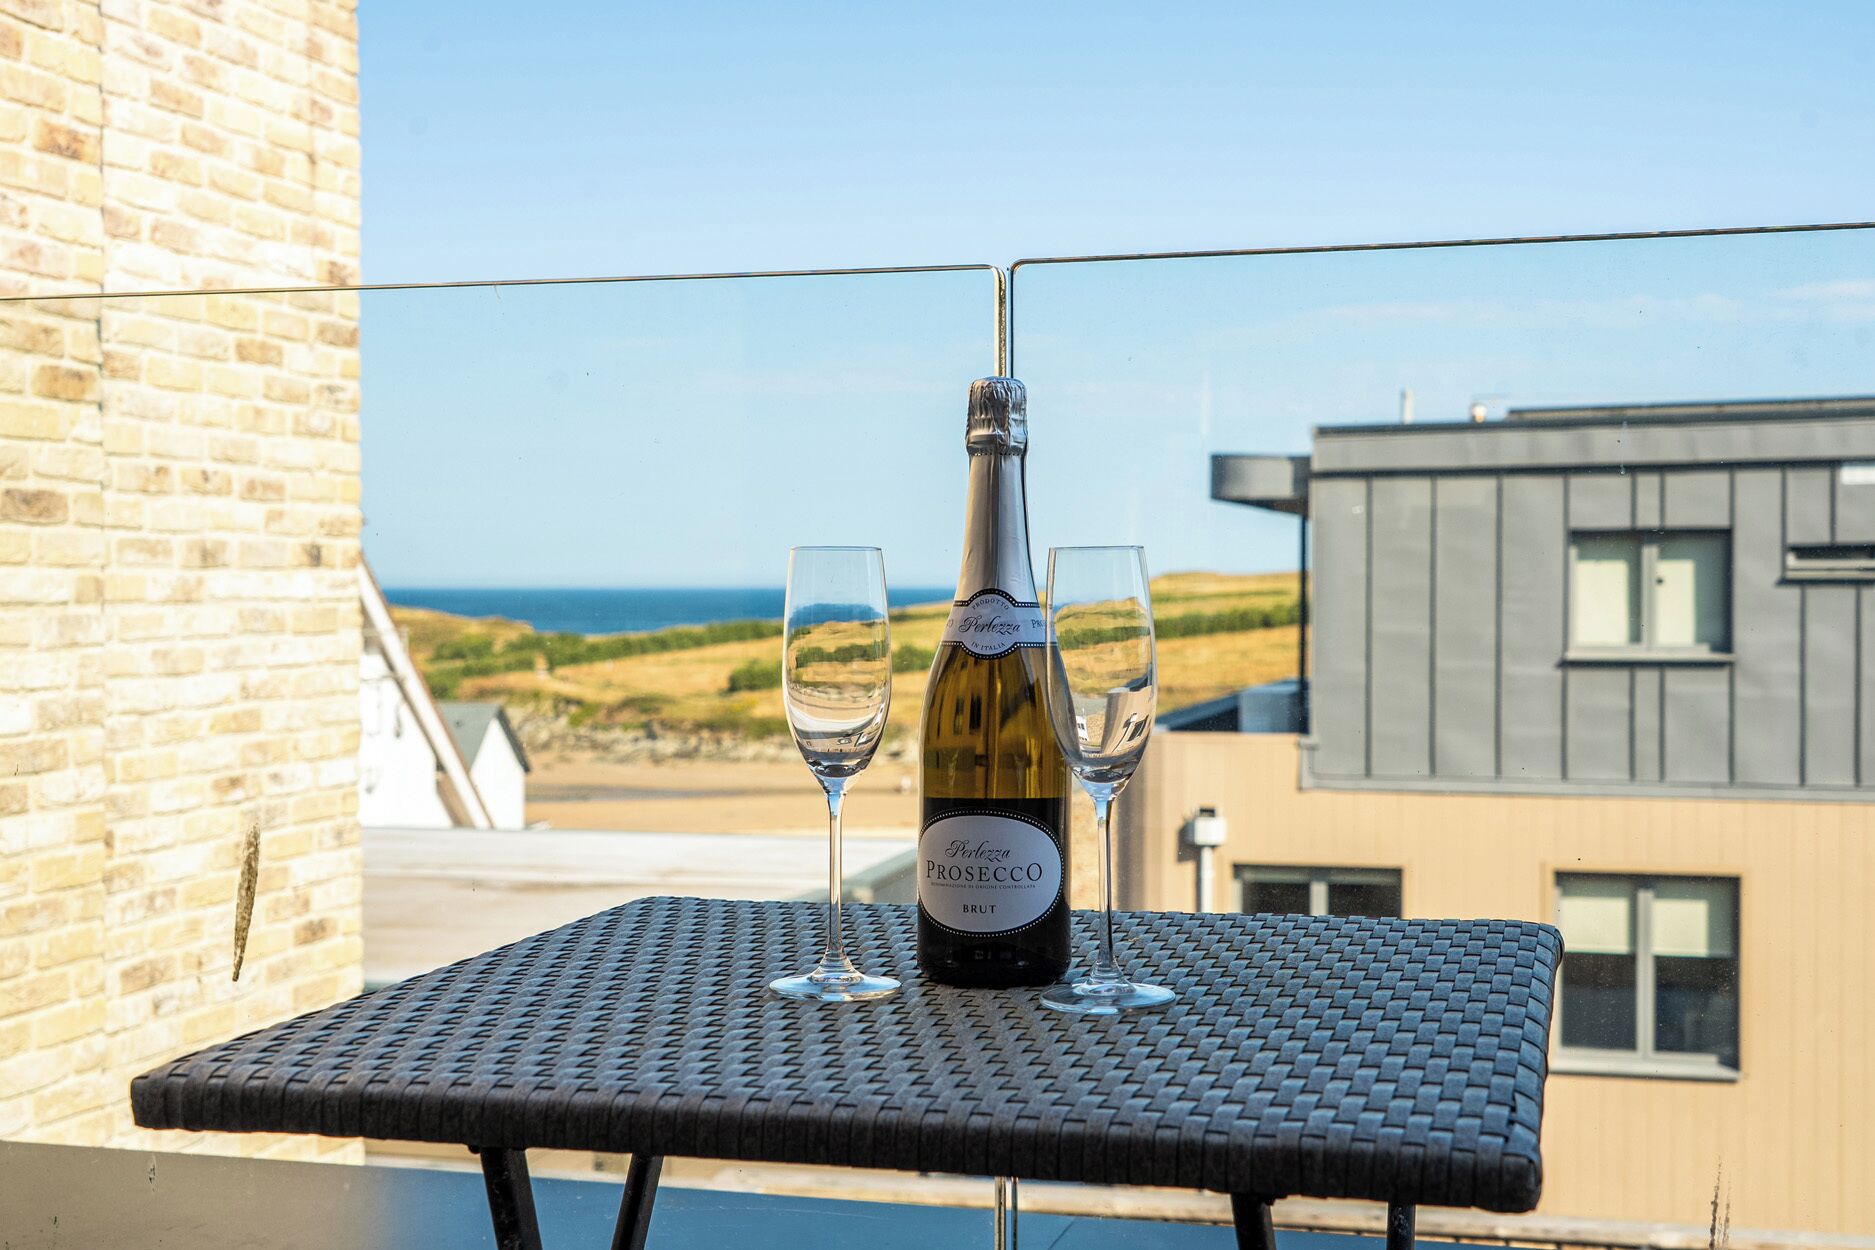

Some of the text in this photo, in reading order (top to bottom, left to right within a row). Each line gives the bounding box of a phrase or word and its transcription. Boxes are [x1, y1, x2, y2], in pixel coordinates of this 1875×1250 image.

[972, 598, 1009, 610] PRODOTTO
[959, 615, 1021, 635] Perlezza
[980, 642, 1006, 651] ITALIA
[945, 839, 1010, 862] Perlezza
[926, 860, 1043, 882] PROSECCO
[962, 904, 997, 914] BRUT
